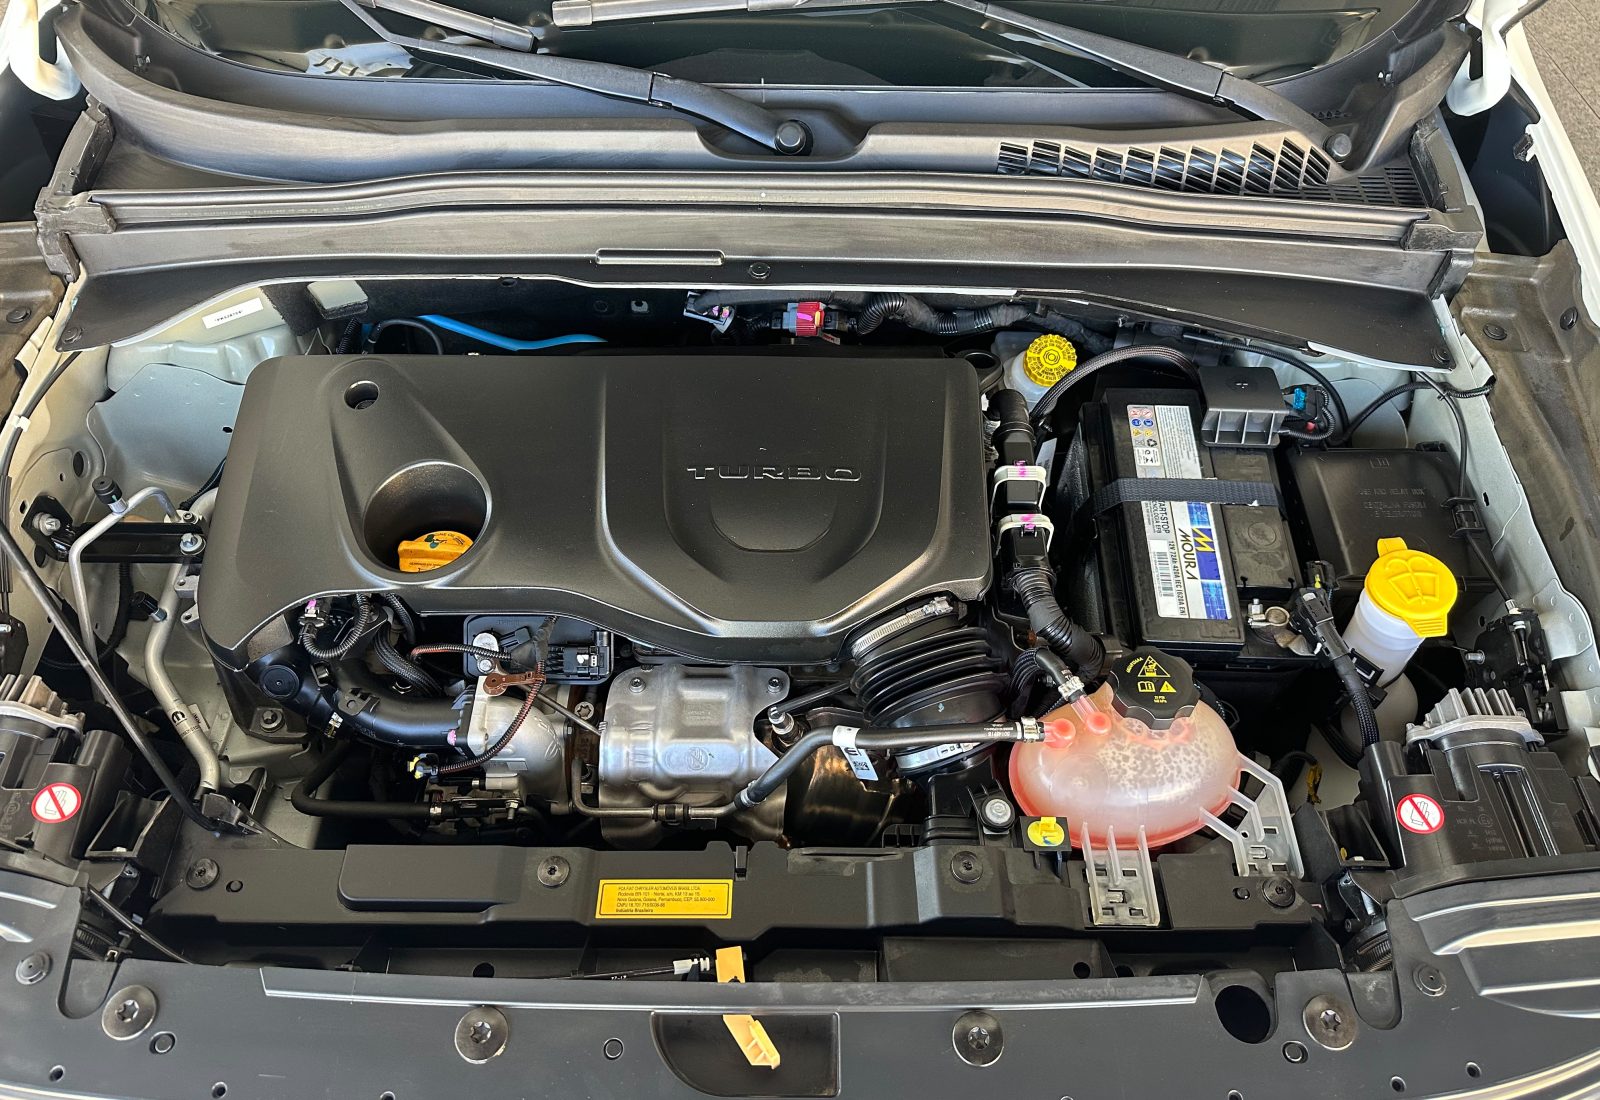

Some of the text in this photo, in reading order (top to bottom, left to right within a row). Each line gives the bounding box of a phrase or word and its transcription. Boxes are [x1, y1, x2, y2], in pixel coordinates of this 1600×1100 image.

[686, 465, 862, 482] TURBO
[1158, 501, 1170, 534] TART-STOP
[1178, 528, 1198, 581] MOURA
